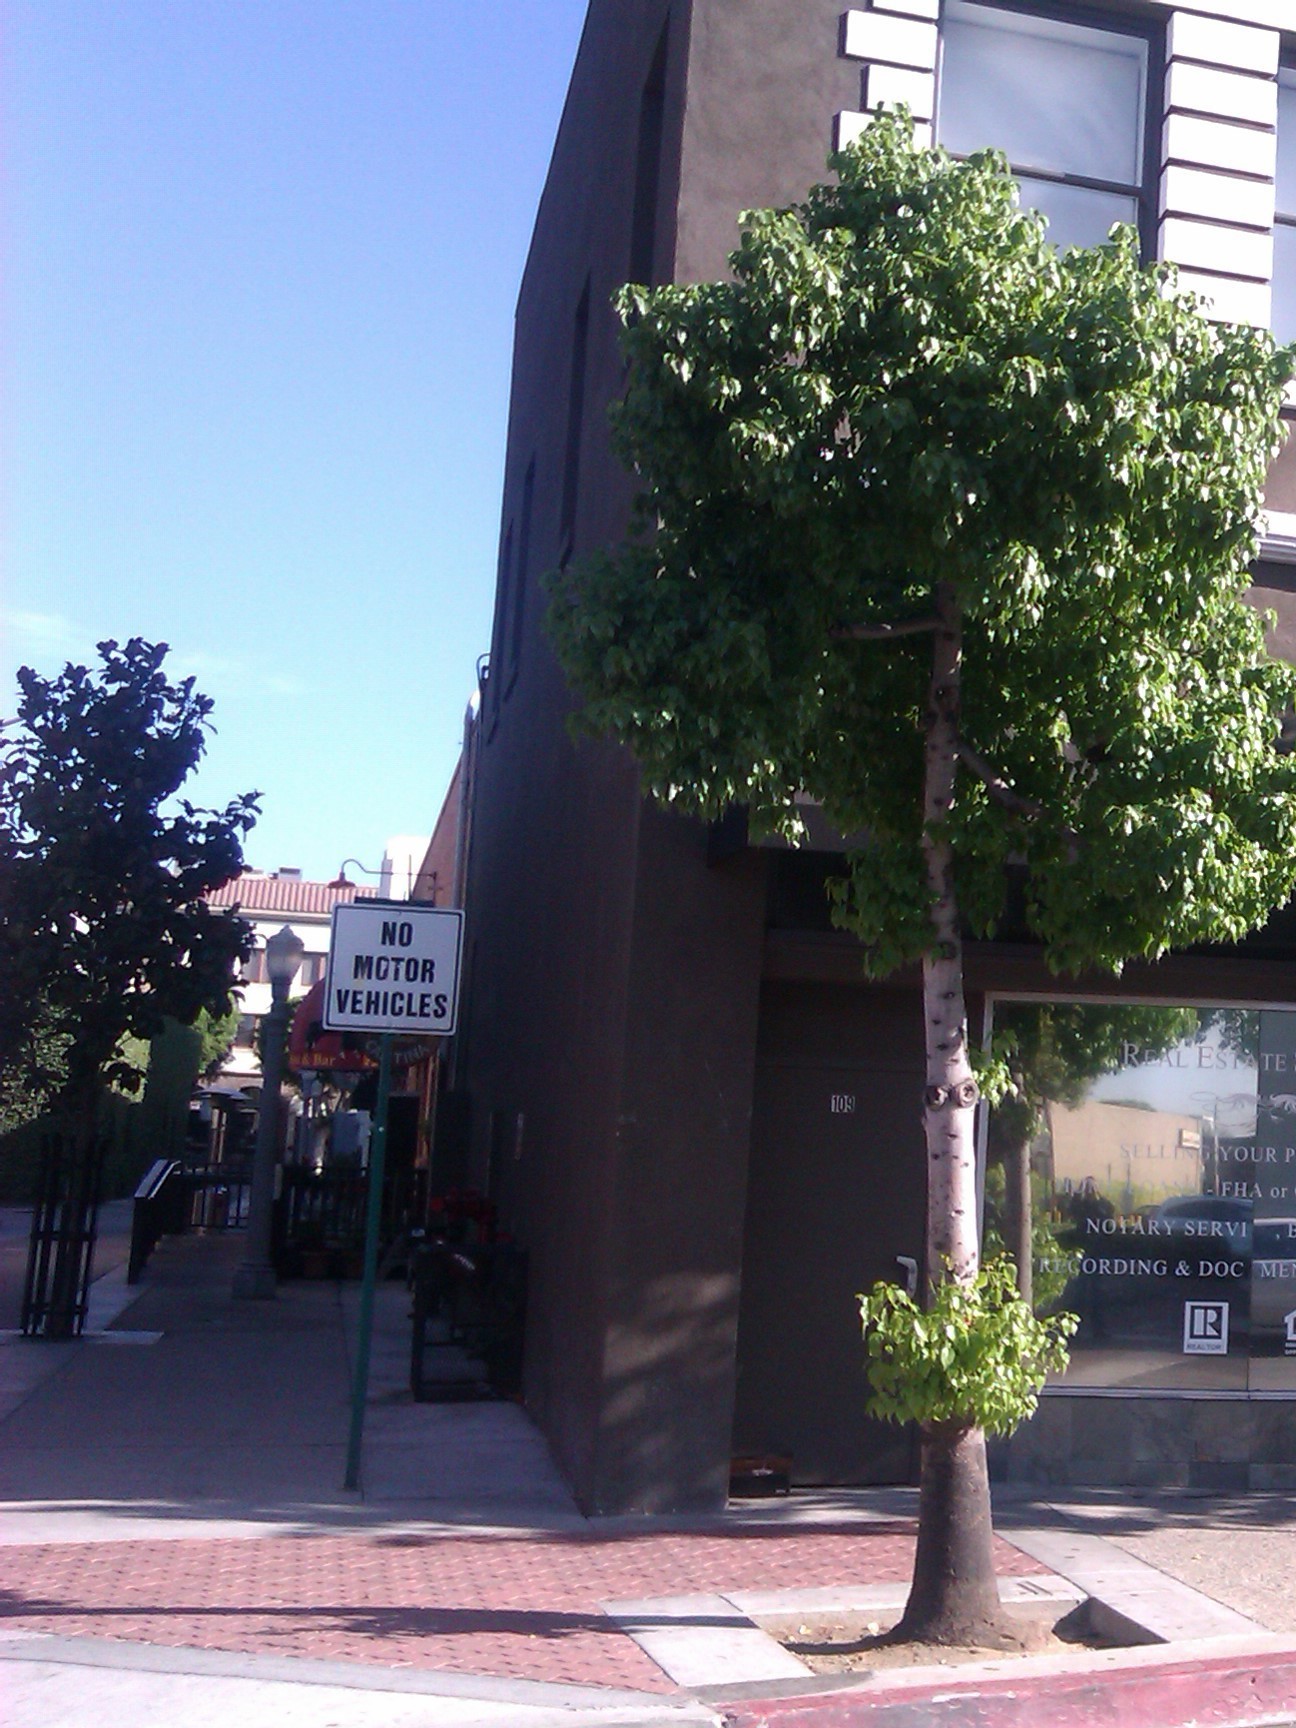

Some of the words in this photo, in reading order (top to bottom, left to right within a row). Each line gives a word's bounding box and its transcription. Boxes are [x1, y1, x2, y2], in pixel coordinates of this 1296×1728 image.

[381, 921, 413, 947] NO
[353, 954, 435, 984] MOTOR
[336, 988, 448, 1019] VEHICLES
[1123, 1041, 1189, 1069] REAL
[1220, 1146, 1278, 1163] YOUR
[1222, 1181, 1263, 1199] FHA
[1270, 1186, 1288, 1199] or
[1086, 1217, 1175, 1236] NOTARY
[1039, 1257, 1168, 1276] RECORDING
[1174, 1259, 1191, 1277] &
